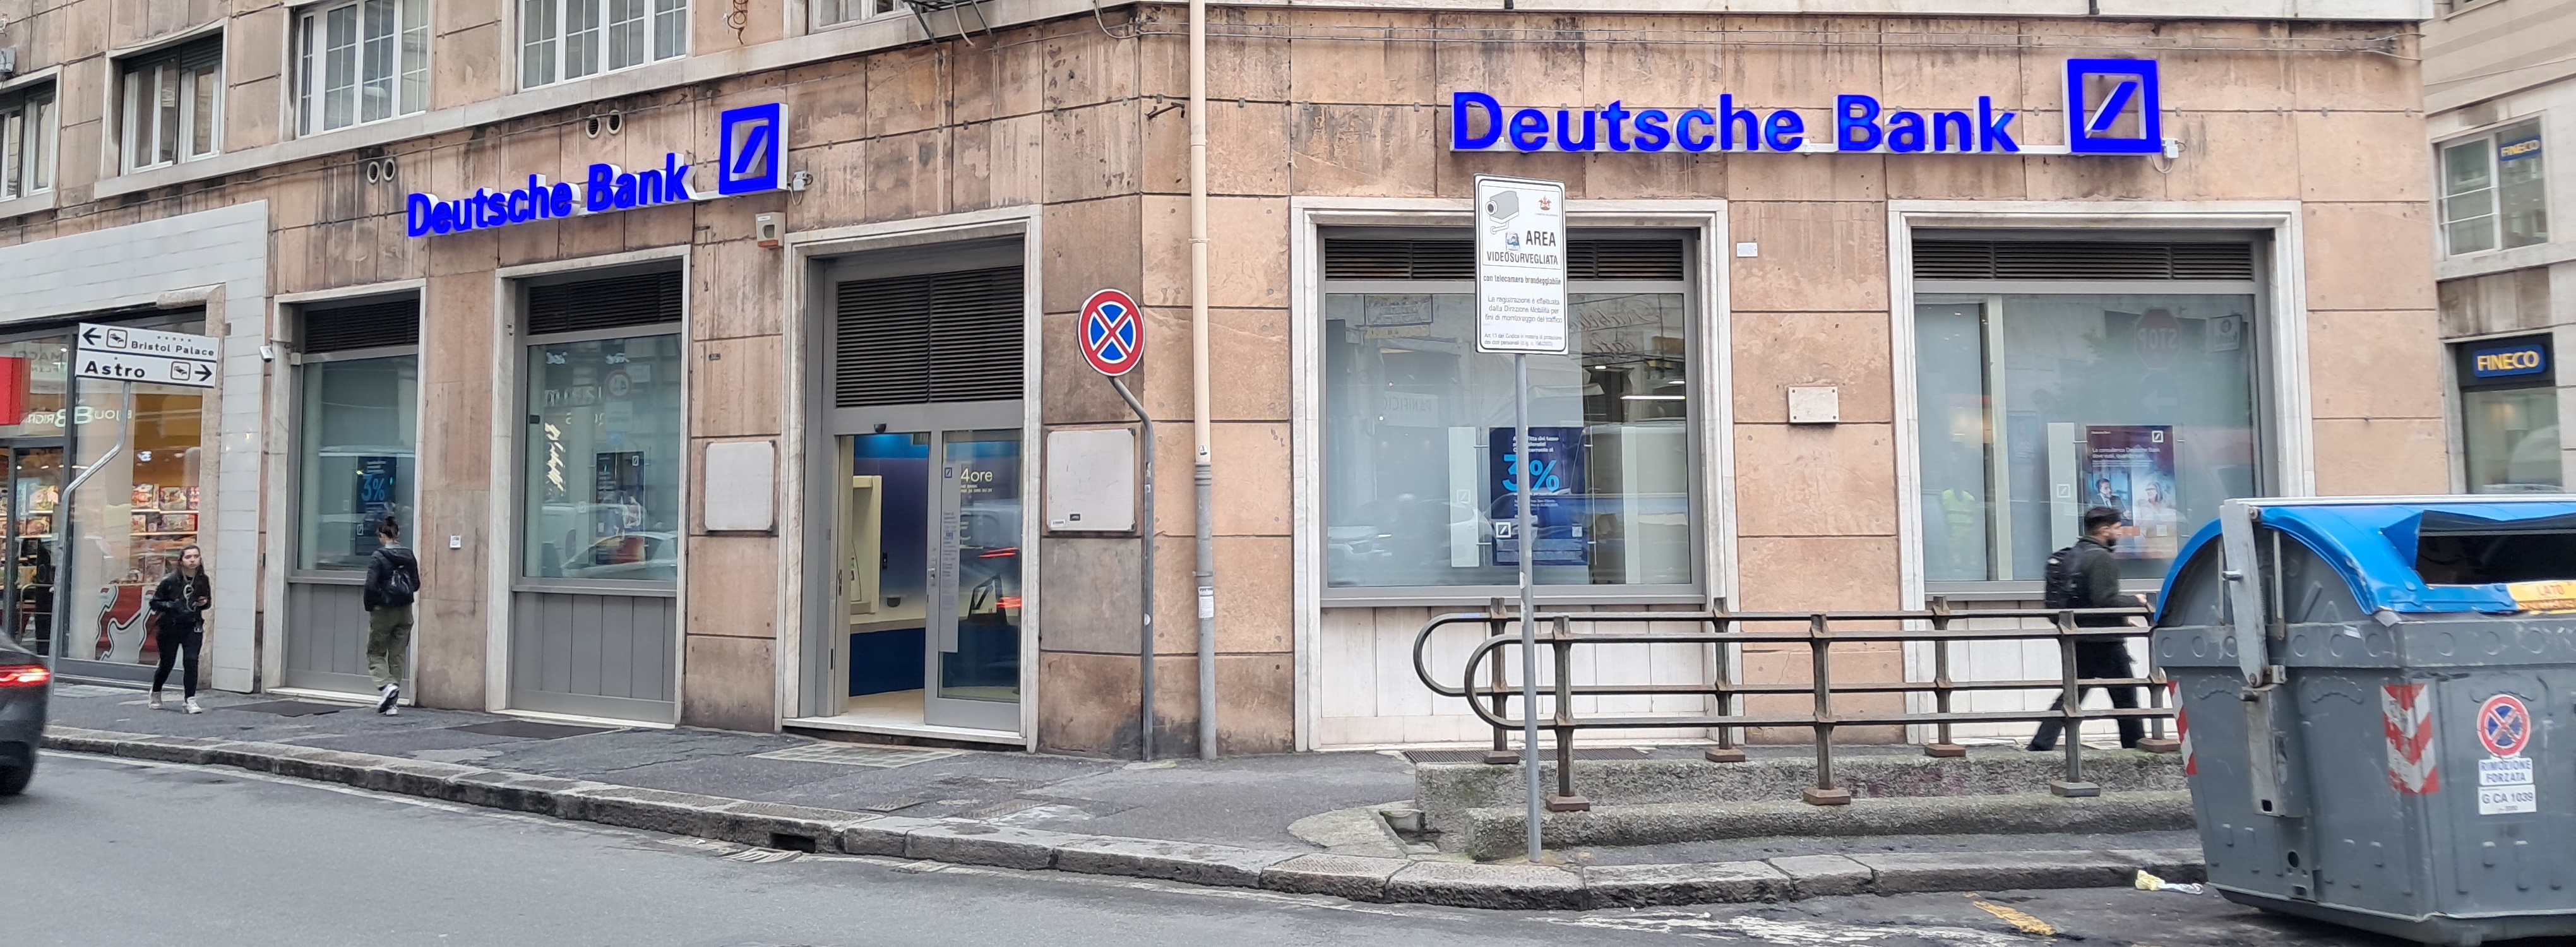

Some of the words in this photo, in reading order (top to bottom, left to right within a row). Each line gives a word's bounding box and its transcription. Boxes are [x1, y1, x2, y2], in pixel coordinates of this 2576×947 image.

[1452, 92, 1804, 152] Deutsche
[1835, 95, 2019, 153] Bank
[2500, 139, 2539, 157] FINECO
[407, 174, 578, 237] Deutsche
[588, 152, 693, 211] Bank
[1525, 230, 1556, 247] AREA
[1486, 251, 1558, 265] VIDEOSURVEGLIATA
[1494, 275, 1524, 283] telecamera
[131, 341, 171, 352] Bristol
[175, 345, 215, 356] Palace
[84, 360, 146, 378] Astro
[2477, 350, 2540, 372] FINECO
[960, 467, 993, 482] 4ore
[1502, 454, 1560, 491] 3%
[361, 474, 386, 501] 3%
[2536, 585, 2565, 595] LATO
[2480, 759, 2531, 771] RIMOZIONE
[2486, 772, 2527, 783] FORZATA
[2482, 794, 2491, 804] G
[2493, 792, 2509, 804] CA
[2511, 792, 2533, 802] 1039
